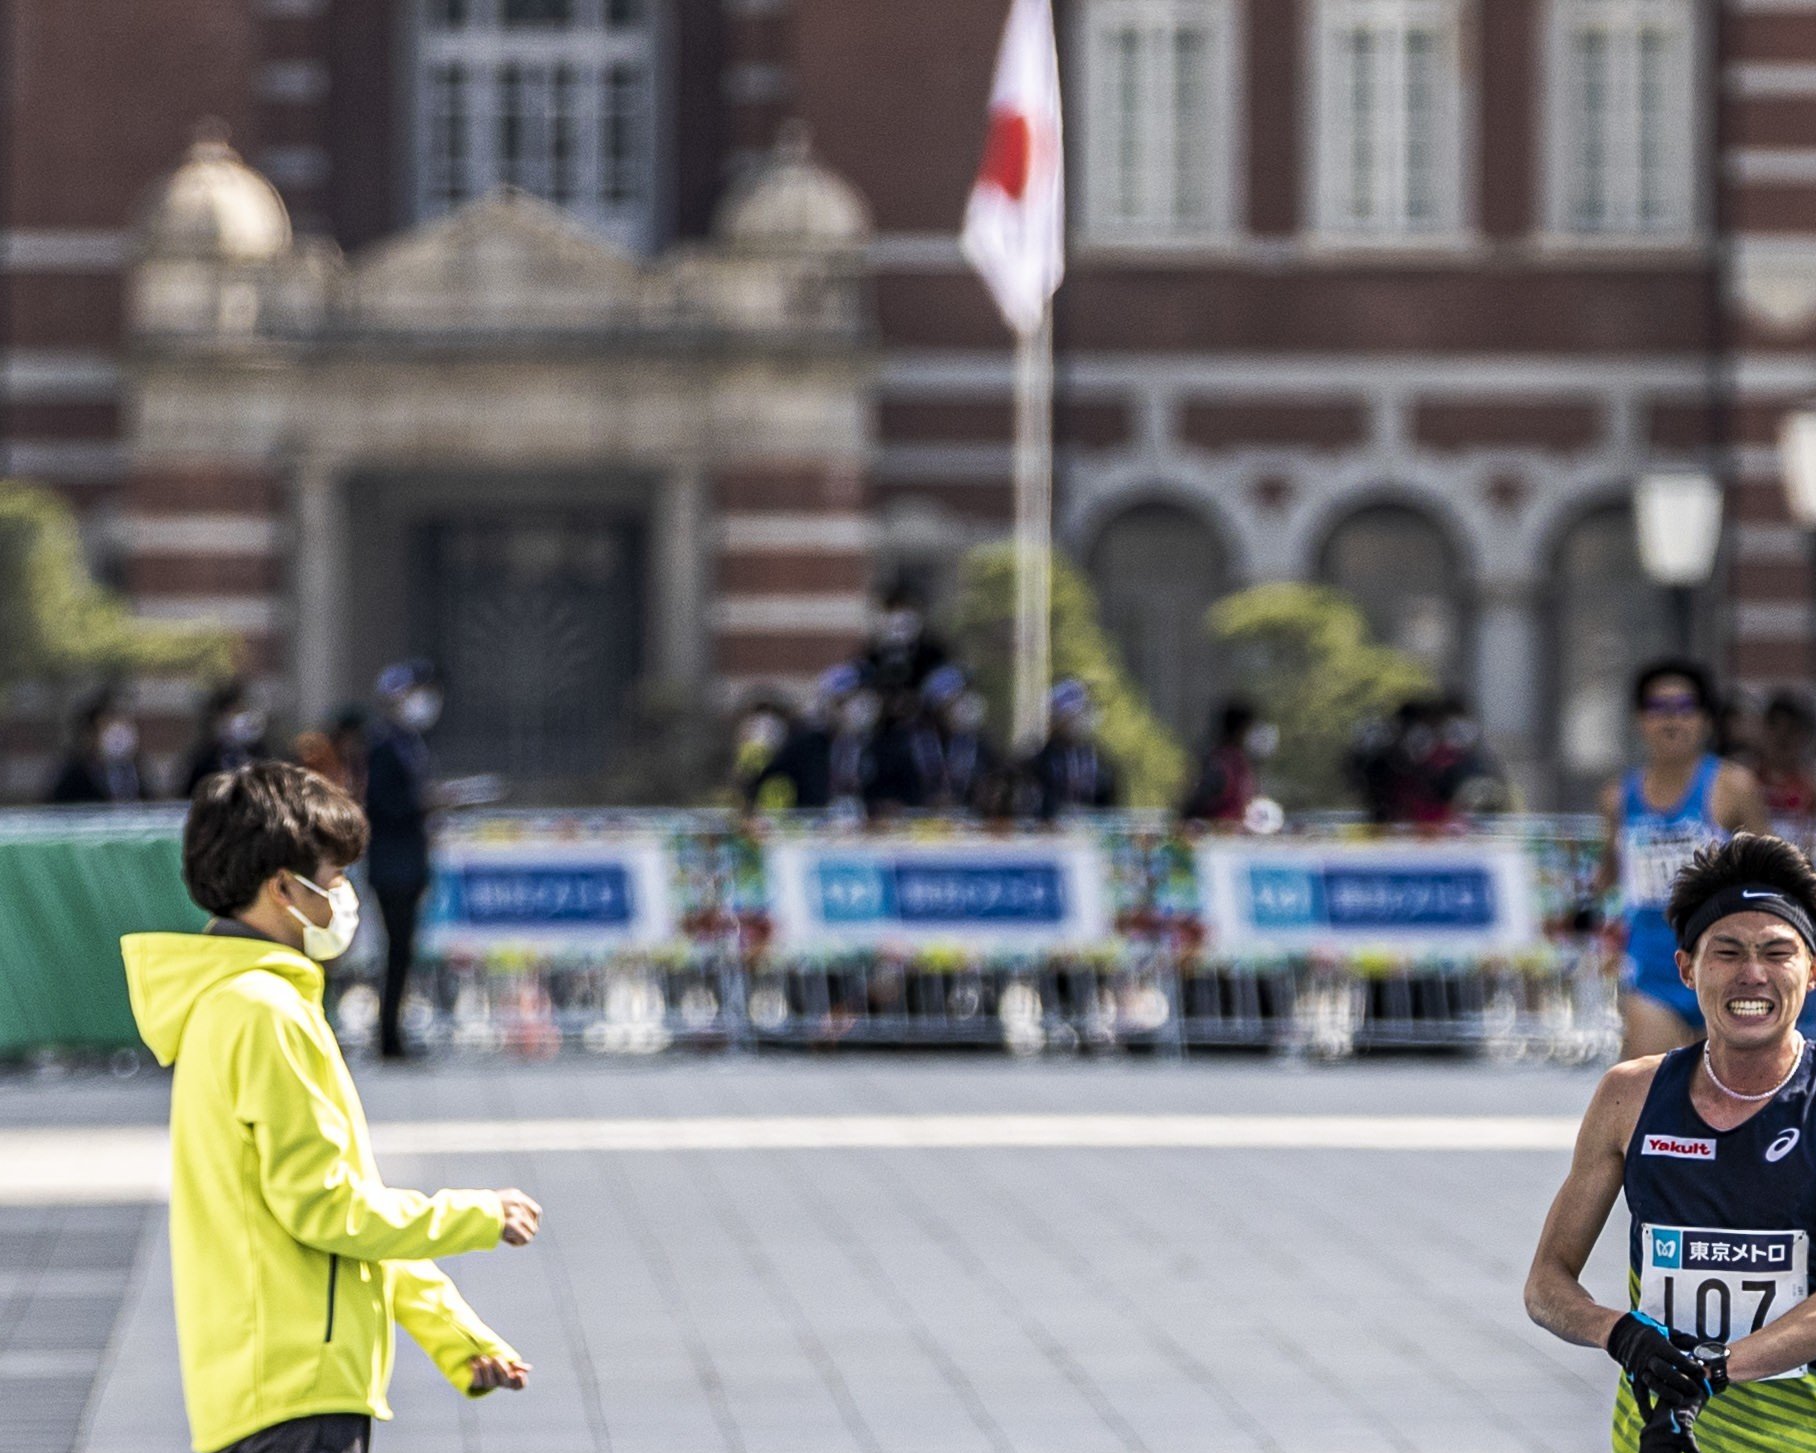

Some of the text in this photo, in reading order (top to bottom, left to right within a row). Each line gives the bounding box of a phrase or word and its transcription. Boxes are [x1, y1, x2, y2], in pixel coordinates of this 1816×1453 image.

[1649, 1139, 1711, 1156] Yakult
[1689, 1241, 1785, 1263] 東京メトロ
